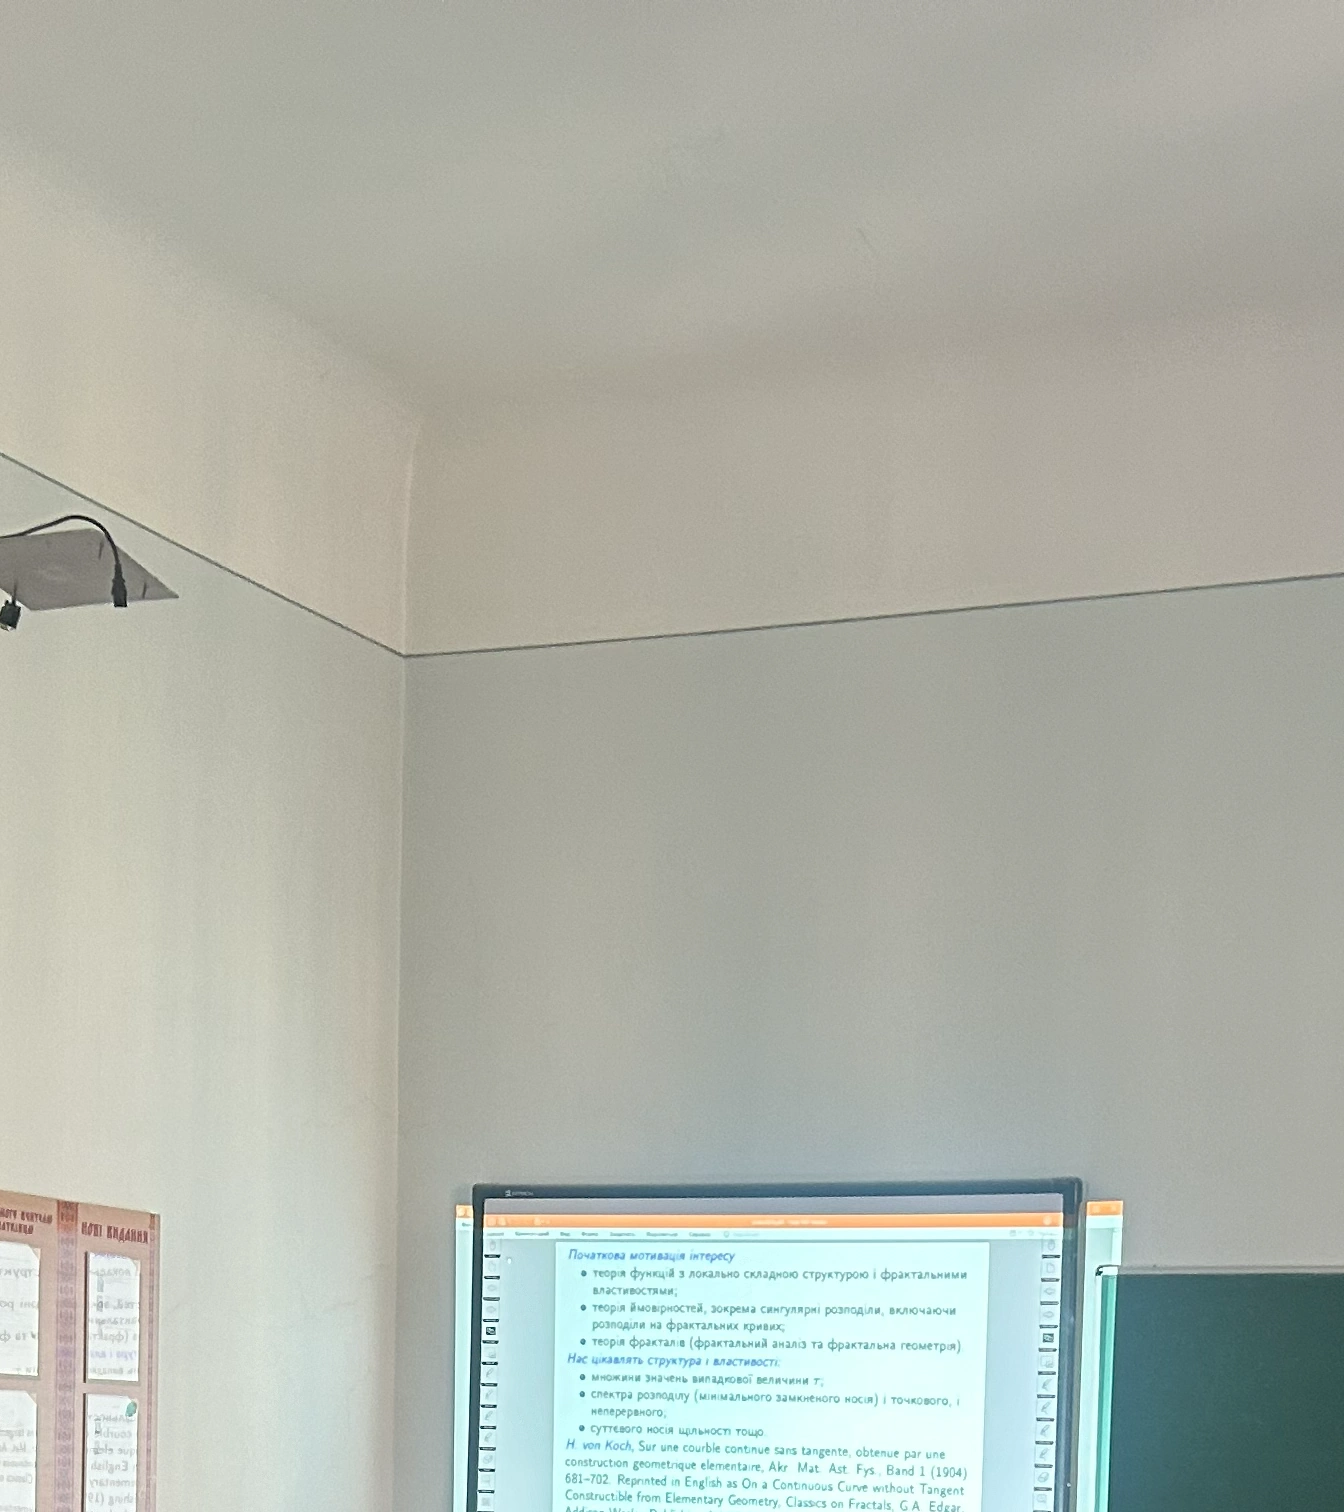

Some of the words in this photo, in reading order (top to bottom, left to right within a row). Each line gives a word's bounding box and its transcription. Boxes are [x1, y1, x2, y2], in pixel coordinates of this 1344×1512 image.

[81, 1221, 103, 1238] НОВІ
[106, 1225, 149, 1245] ВИДАННЯ
[568, 1248, 626, 1261] Початкова
[630, 1250, 686, 1263] мотивація
[690, 1249, 736, 1264] інтересу
[593, 1268, 626, 1280] теорія
[630, 1267, 675, 1282] функцій
[678, 1270, 685, 1279] з
[689, 1269, 740, 1280] локально
[743, 1269, 799, 1282] складною
[802, 1270, 869, 1283] структурою
[880, 1267, 968, 1283] фрактальними
[592, 1286, 678, 1297] властивостями;
[592, 1303, 626, 1315] теорія
[630, 1302, 707, 1316] ймовірностей,
[711, 1305, 756, 1317] зокрема
[760, 1303, 821, 1318] сингулярні
[825, 1304, 885, 1317] розподіли,
[889, 1306, 956, 1316] включаючи
[592, 1318, 646, 1332] розподіли
[650, 1321, 662, 1330] на
[666, 1318, 739, 1333] фрактальних
[743, 1322, 786, 1333] кривих;
[592, 1337, 625, 1349] теорія
[629, 1335, 686, 1350] фракталів
[689, 1335, 768, 1351] (фрактальний
[772, 1338, 807, 1349] аналіз
[811, 1340, 823, 1350] та
[827, 1338, 896, 1353] фрактальна
[567, 1353, 588, 1365] Нас
[591, 1354, 644, 1366] цікавлять
[647, 1356, 702, 1368] структура
[713, 1357, 782, 1368] властивості:
[591, 1374, 641, 1383] множини
[645, 1374, 689, 1384] значень
[692, 1374, 753, 1385] випадкової
[756, 1376, 809, 1386] величини
[591, 1391, 633, 1402] спектра
[637, 1391, 690, 1404] розподілу
[694, 1389, 772, 1403] (мінімального
[775, 1394, 841, 1404] замкненого
[844, 1393, 879, 1408] носія)
[891, 1396, 953, 1408] точкового,
[591, 1407, 668, 1420] неперервного;
[590, 1425, 643, 1436] суттєвого
[646, 1424, 674, 1435] носія
[678, 1425, 732, 1437] щільності
[582, 1442, 601, 1450] von
[605, 1440, 635, 1453] Koch,
[638, 1440, 656, 1452] Sur
[661, 1444, 679, 1452] une
[682, 1442, 721, 1453] courble
[724, 1444, 770, 1455] continue
[774, 1446, 797, 1456] sans
[801, 1446, 852, 1459] tangente,
[856, 1446, 900, 1458] obtenue
[904, 1450, 922, 1461] par
[925, 1451, 946, 1460] une
[564, 1458, 628, 1468] construction
[632, 1459, 697, 1472] geometrique
[700, 1459, 765, 1473] elementaire,
[886, 1464, 915, 1477] Band
[919, 1466, 925, 1476] 1
[931, 1466, 968, 1481] (1904)
[617, 1474, 667, 1488] Reprinted
[671, 1476, 680, 1487] in
[684, 1476, 722, 1490] English
[726, 1481, 738, 1489] as
[742, 1477, 758, 1489] On
[761, 1482, 768, 1490] a
[772, 1478, 833, 1492] Continuous
[837, 1480, 869, 1493] Curve
[872, 1482, 915, 1494] without
[919, 1483, 965, 1498] Tangent
[565, 1488, 633, 1502] Constructible
[636, 1490, 661, 1503] from
[665, 1492, 724, 1507] Elementary
[728, 1494, 782, 1509] Geometry,
[830, 1500, 844, 1510] on
[848, 1498, 895, 1512] Fractals,
